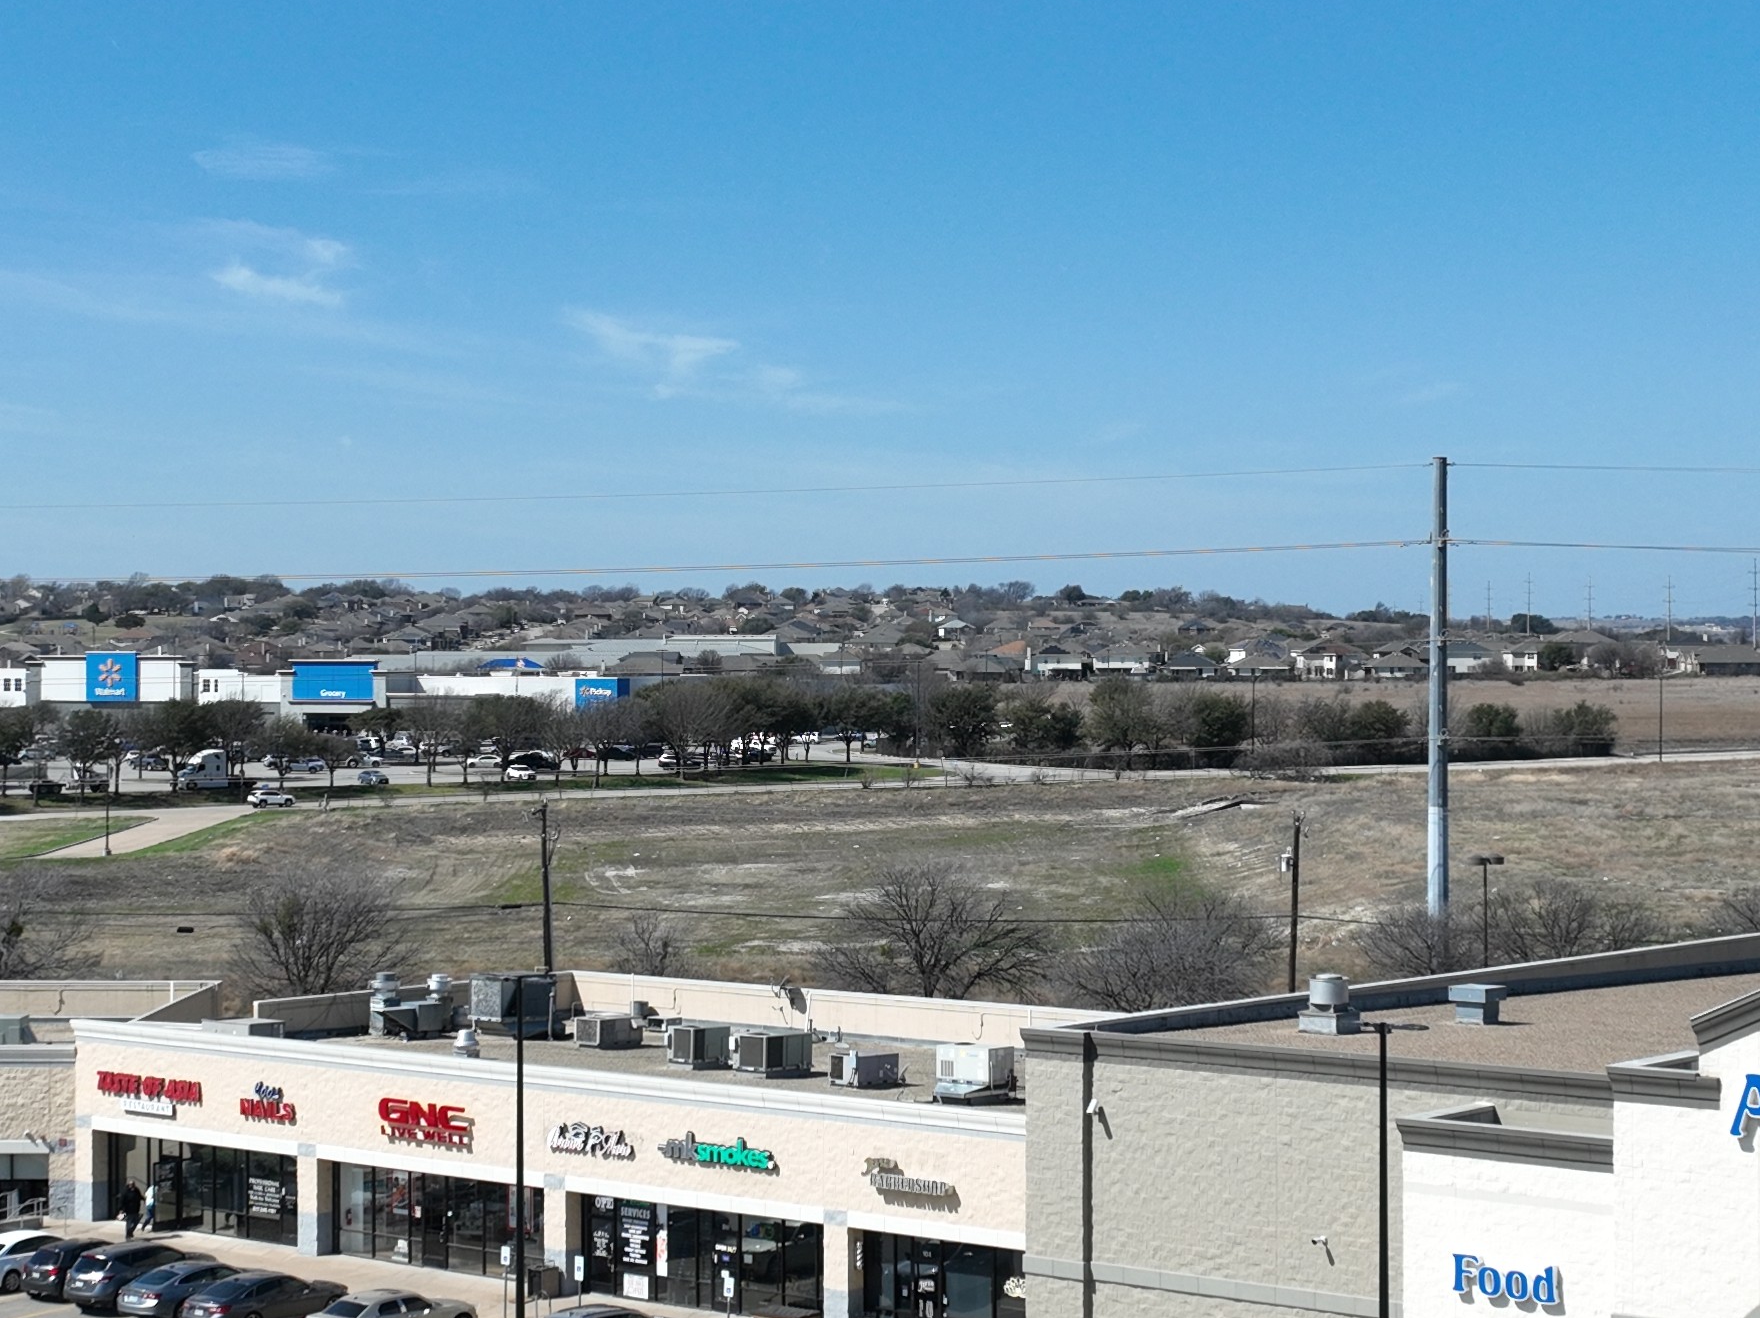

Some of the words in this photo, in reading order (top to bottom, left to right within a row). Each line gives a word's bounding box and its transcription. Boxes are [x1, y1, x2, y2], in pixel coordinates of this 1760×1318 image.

[97, 1070, 142, 1095] TASTE
[142, 1075, 166, 1098] OF
[165, 1079, 203, 1102] ASIA
[122, 1099, 172, 1114] RESTAURANT
[240, 1098, 295, 1121] NAILS
[378, 1097, 469, 1132] GNC
[380, 1125, 418, 1141] LIVE
[422, 1128, 470, 1146] WELL
[620, 1206, 651, 1220] SERVICES
[1452, 1252, 1559, 1305] Food
